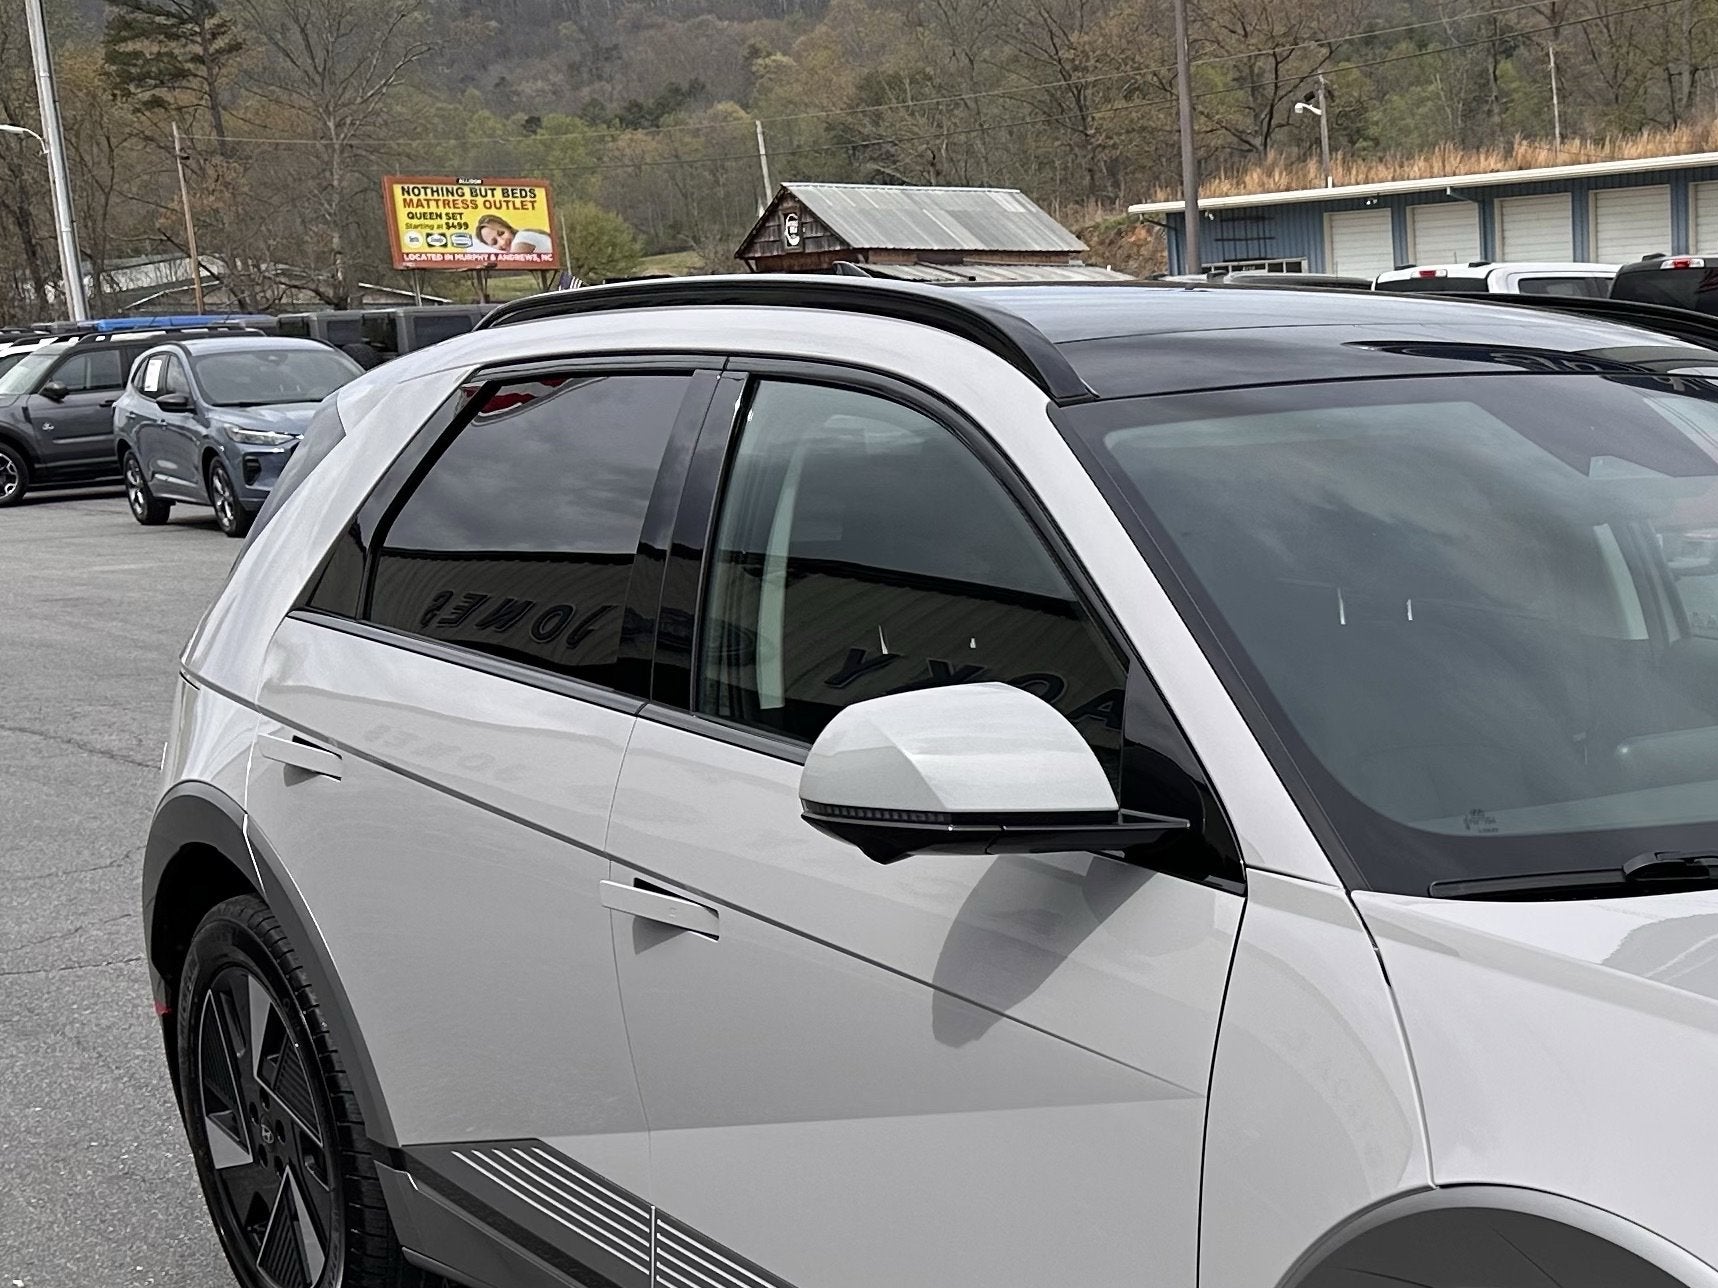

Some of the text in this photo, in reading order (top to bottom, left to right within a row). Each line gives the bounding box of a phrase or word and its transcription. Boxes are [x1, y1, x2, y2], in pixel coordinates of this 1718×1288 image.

[401, 186, 537, 199] NOTHING BUT BEDS
[403, 198, 537, 211] MATTRESS OUTLET
[406, 211, 464, 221] QUEEN SET
[404, 222, 435, 231] Starting
[445, 221, 470, 231] $499
[403, 253, 443, 261] LOCATED
[444, 253, 453, 261] IN
[454, 253, 488, 262] MURPHY
[498, 254, 540, 263] ANDREWS,
[541, 254, 553, 262] NC
